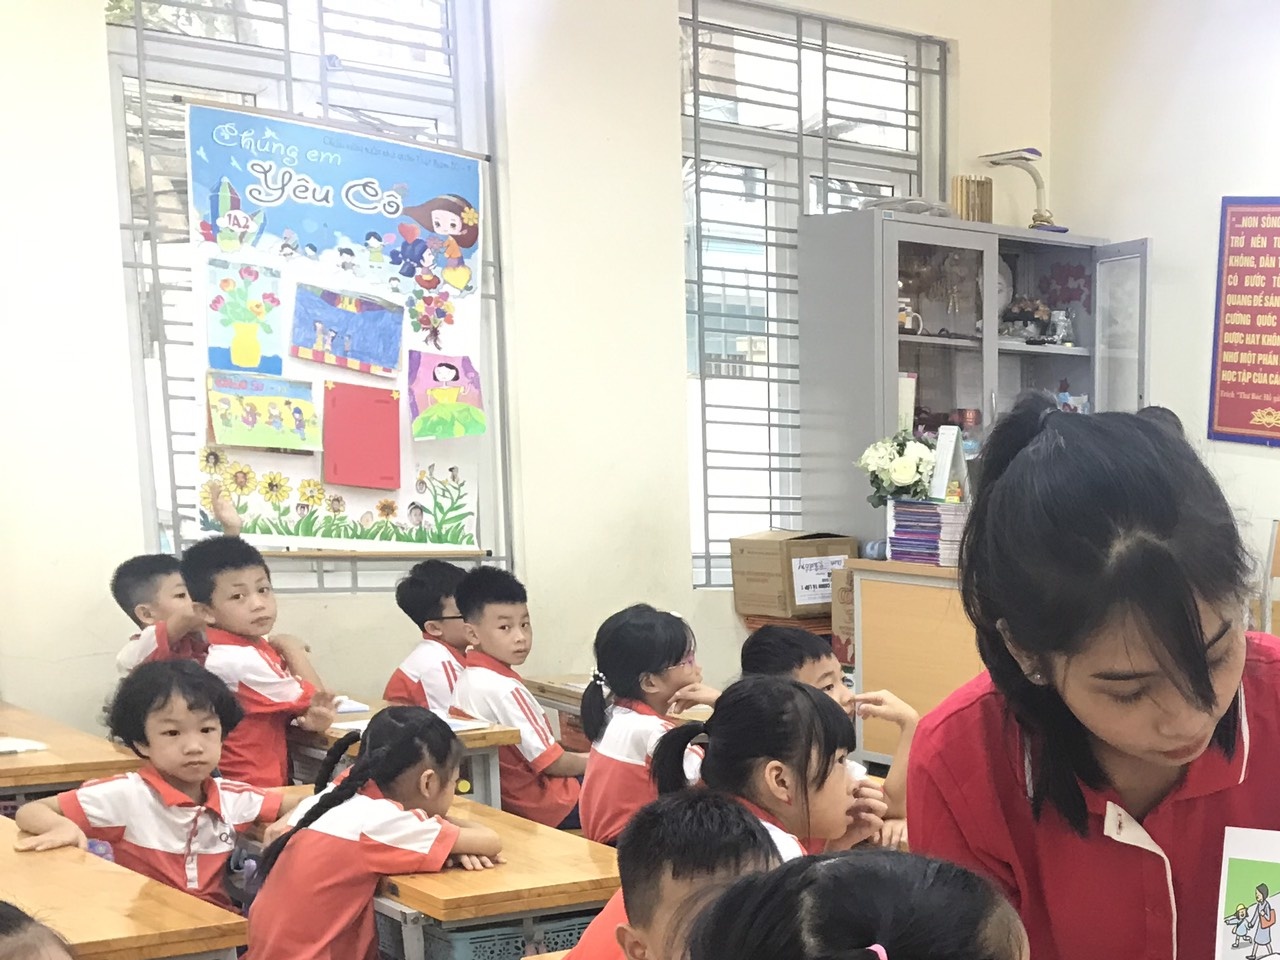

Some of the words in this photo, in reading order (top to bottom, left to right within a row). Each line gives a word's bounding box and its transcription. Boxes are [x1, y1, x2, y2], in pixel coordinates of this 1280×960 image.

[306, 148, 342, 166] em
[248, 161, 331, 205] Yêu
[344, 180, 401, 215] Cô
[226, 212, 250, 230] 1A2
[1250, 234, 1267, 248] NÊN
[1259, 253, 1276, 268] DÂN
[1227, 272, 1239, 286] CÓ
[1226, 293, 1253, 307] QUANG
[1256, 311, 1277, 327] QUỐC
[1245, 333, 1262, 345] HAY
[1240, 350, 1257, 366] MỘT
[1221, 370, 1238, 384] HỌC
[1238, 368, 1253, 385] TẬP
[1252, 367, 1268, 385] CỦA
